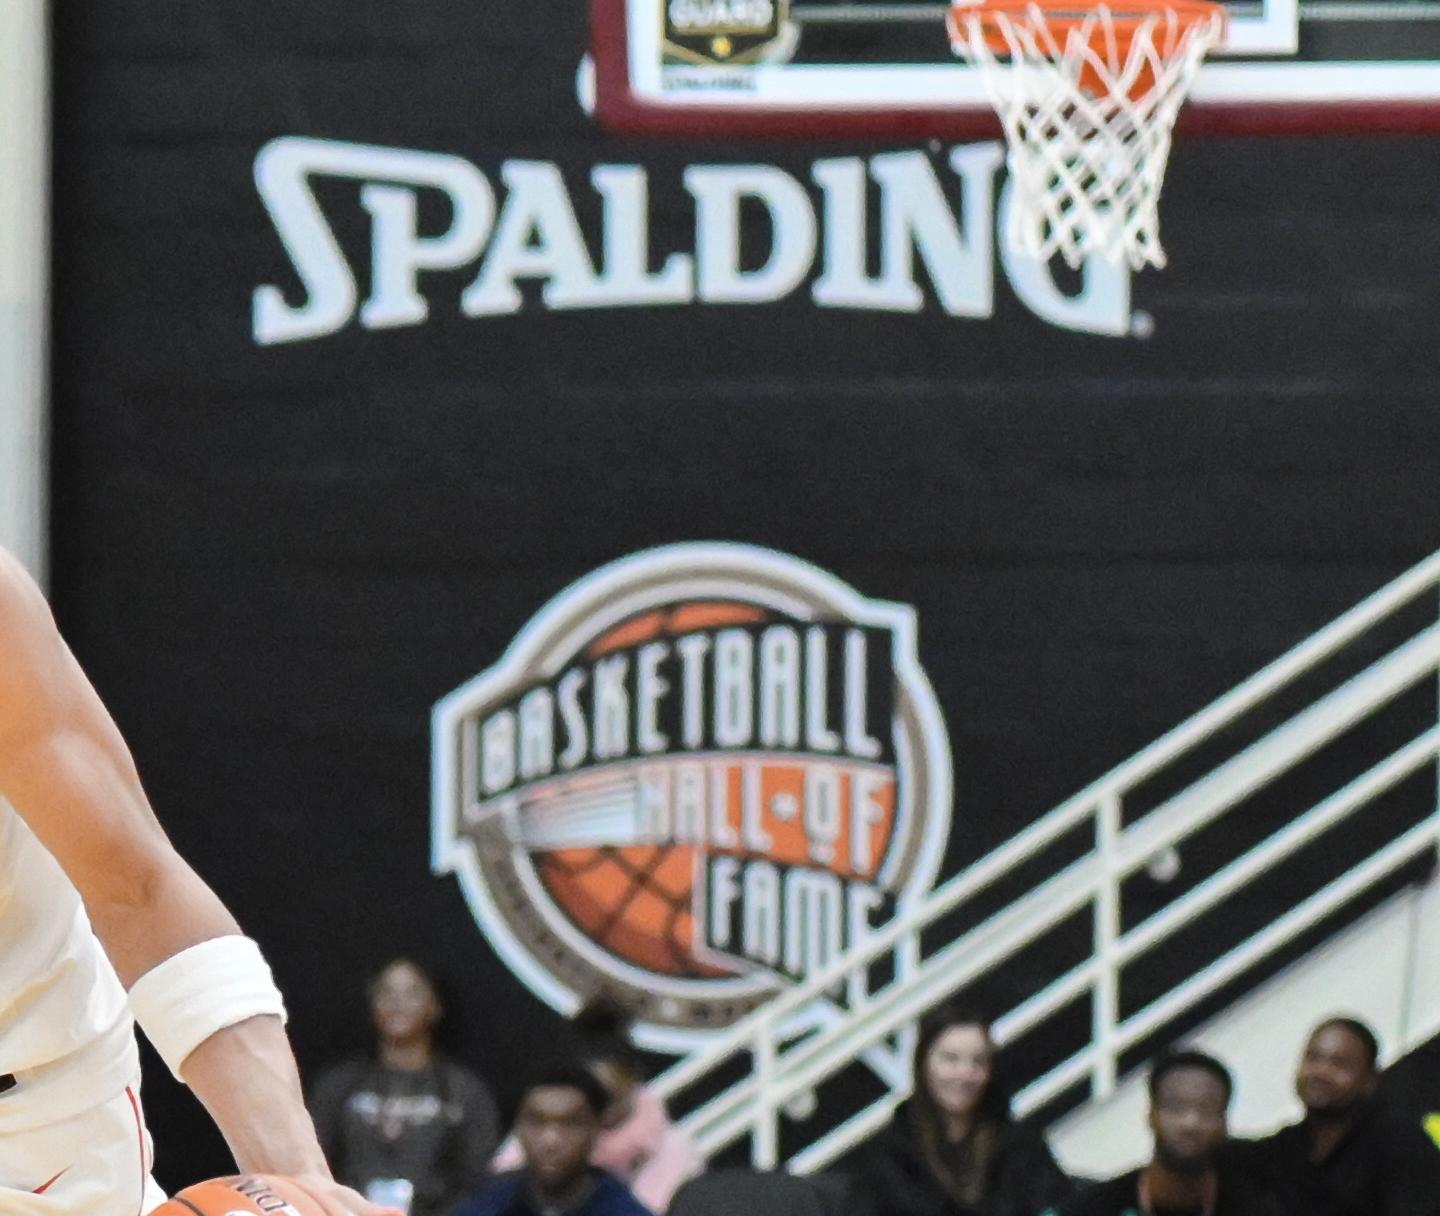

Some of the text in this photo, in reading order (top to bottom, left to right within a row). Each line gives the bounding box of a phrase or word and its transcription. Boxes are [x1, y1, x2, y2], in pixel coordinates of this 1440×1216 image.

[252, 134, 1132, 347] SPALDING
[479, 622, 884, 798] BASKETBALL
[708, 854, 888, 1008] FAME
